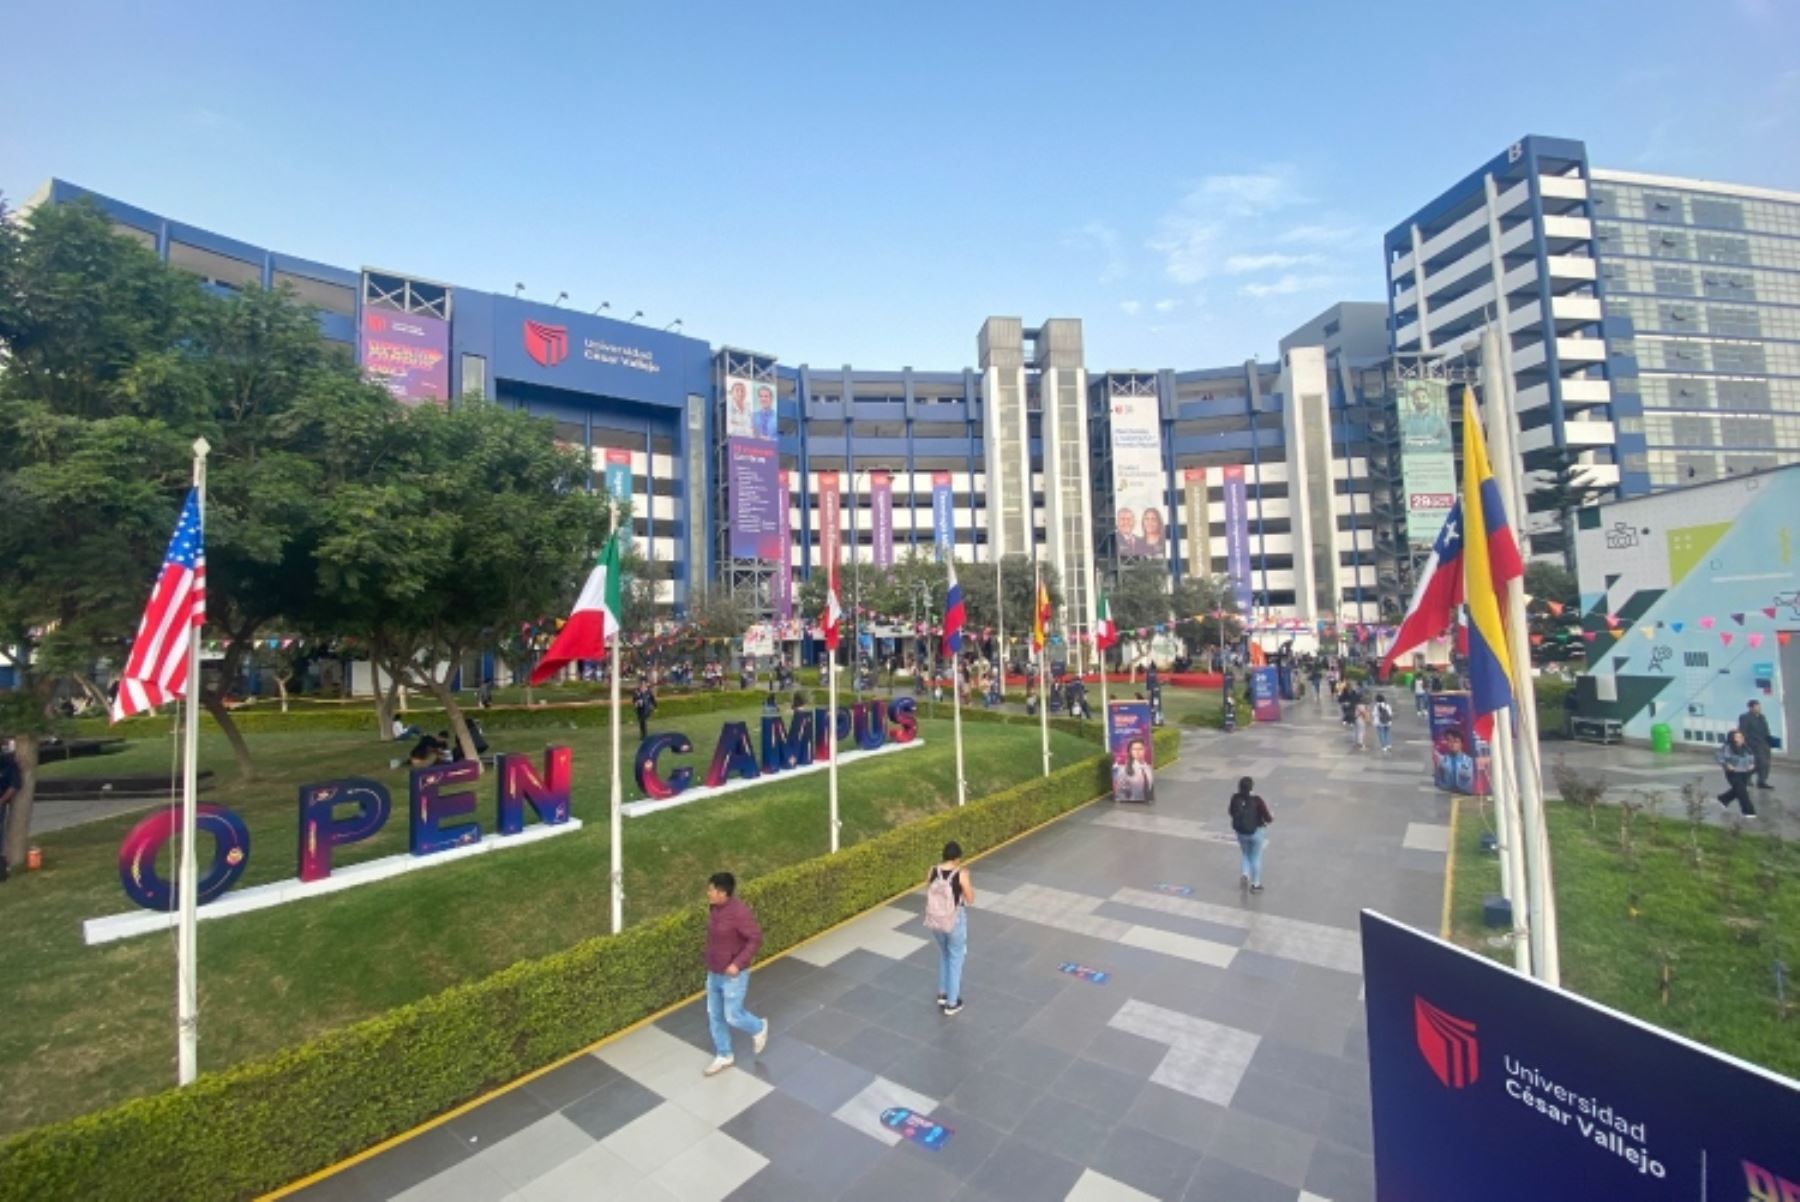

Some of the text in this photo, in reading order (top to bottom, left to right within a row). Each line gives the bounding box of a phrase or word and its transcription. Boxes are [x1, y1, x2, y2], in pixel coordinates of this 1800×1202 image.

[584, 338, 652, 360] Universidad
[620, 355, 660, 373] Vallejo
[119, 697, 918, 912] OPEN CAMPUS
[1504, 1054, 1646, 1144] Universidad
[1505, 1078, 1666, 1178] César Vallejo
